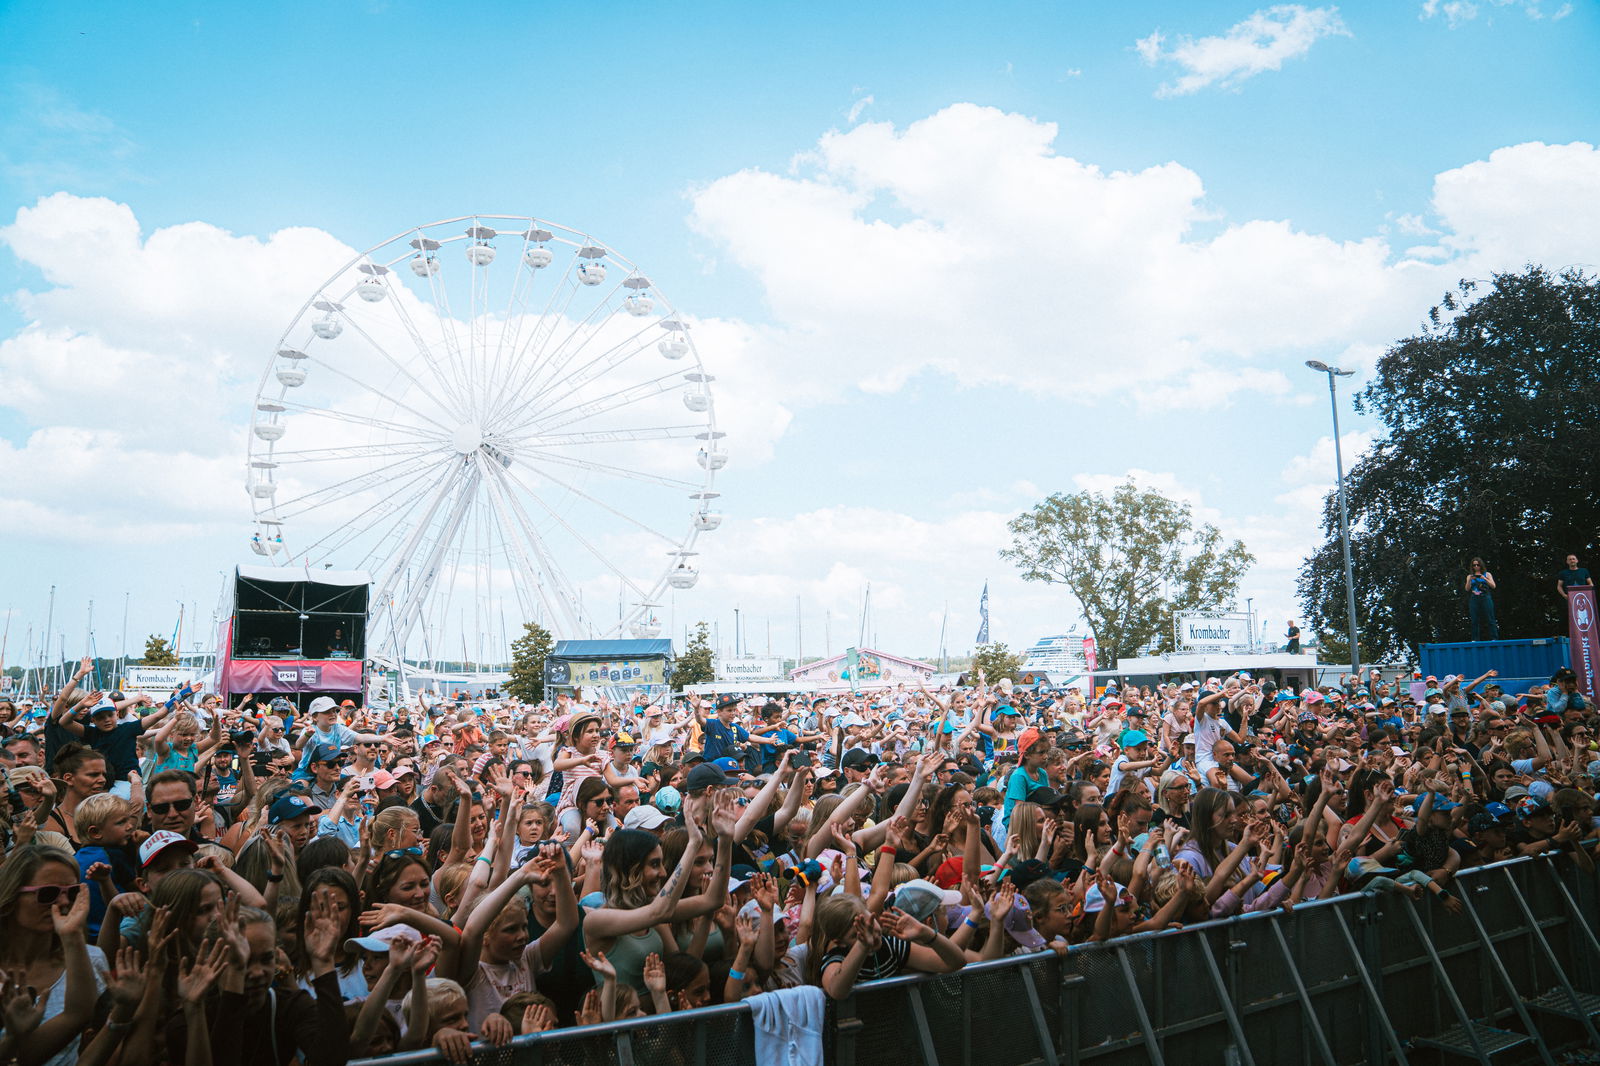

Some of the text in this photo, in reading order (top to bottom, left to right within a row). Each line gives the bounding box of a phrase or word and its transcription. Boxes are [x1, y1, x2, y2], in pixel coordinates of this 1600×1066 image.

[1190, 624, 1230, 639] Krombacher
[726, 664, 762, 673] Krombacher
[136, 674, 177, 682] Krombacher
[145, 831, 174, 850] BULLS
